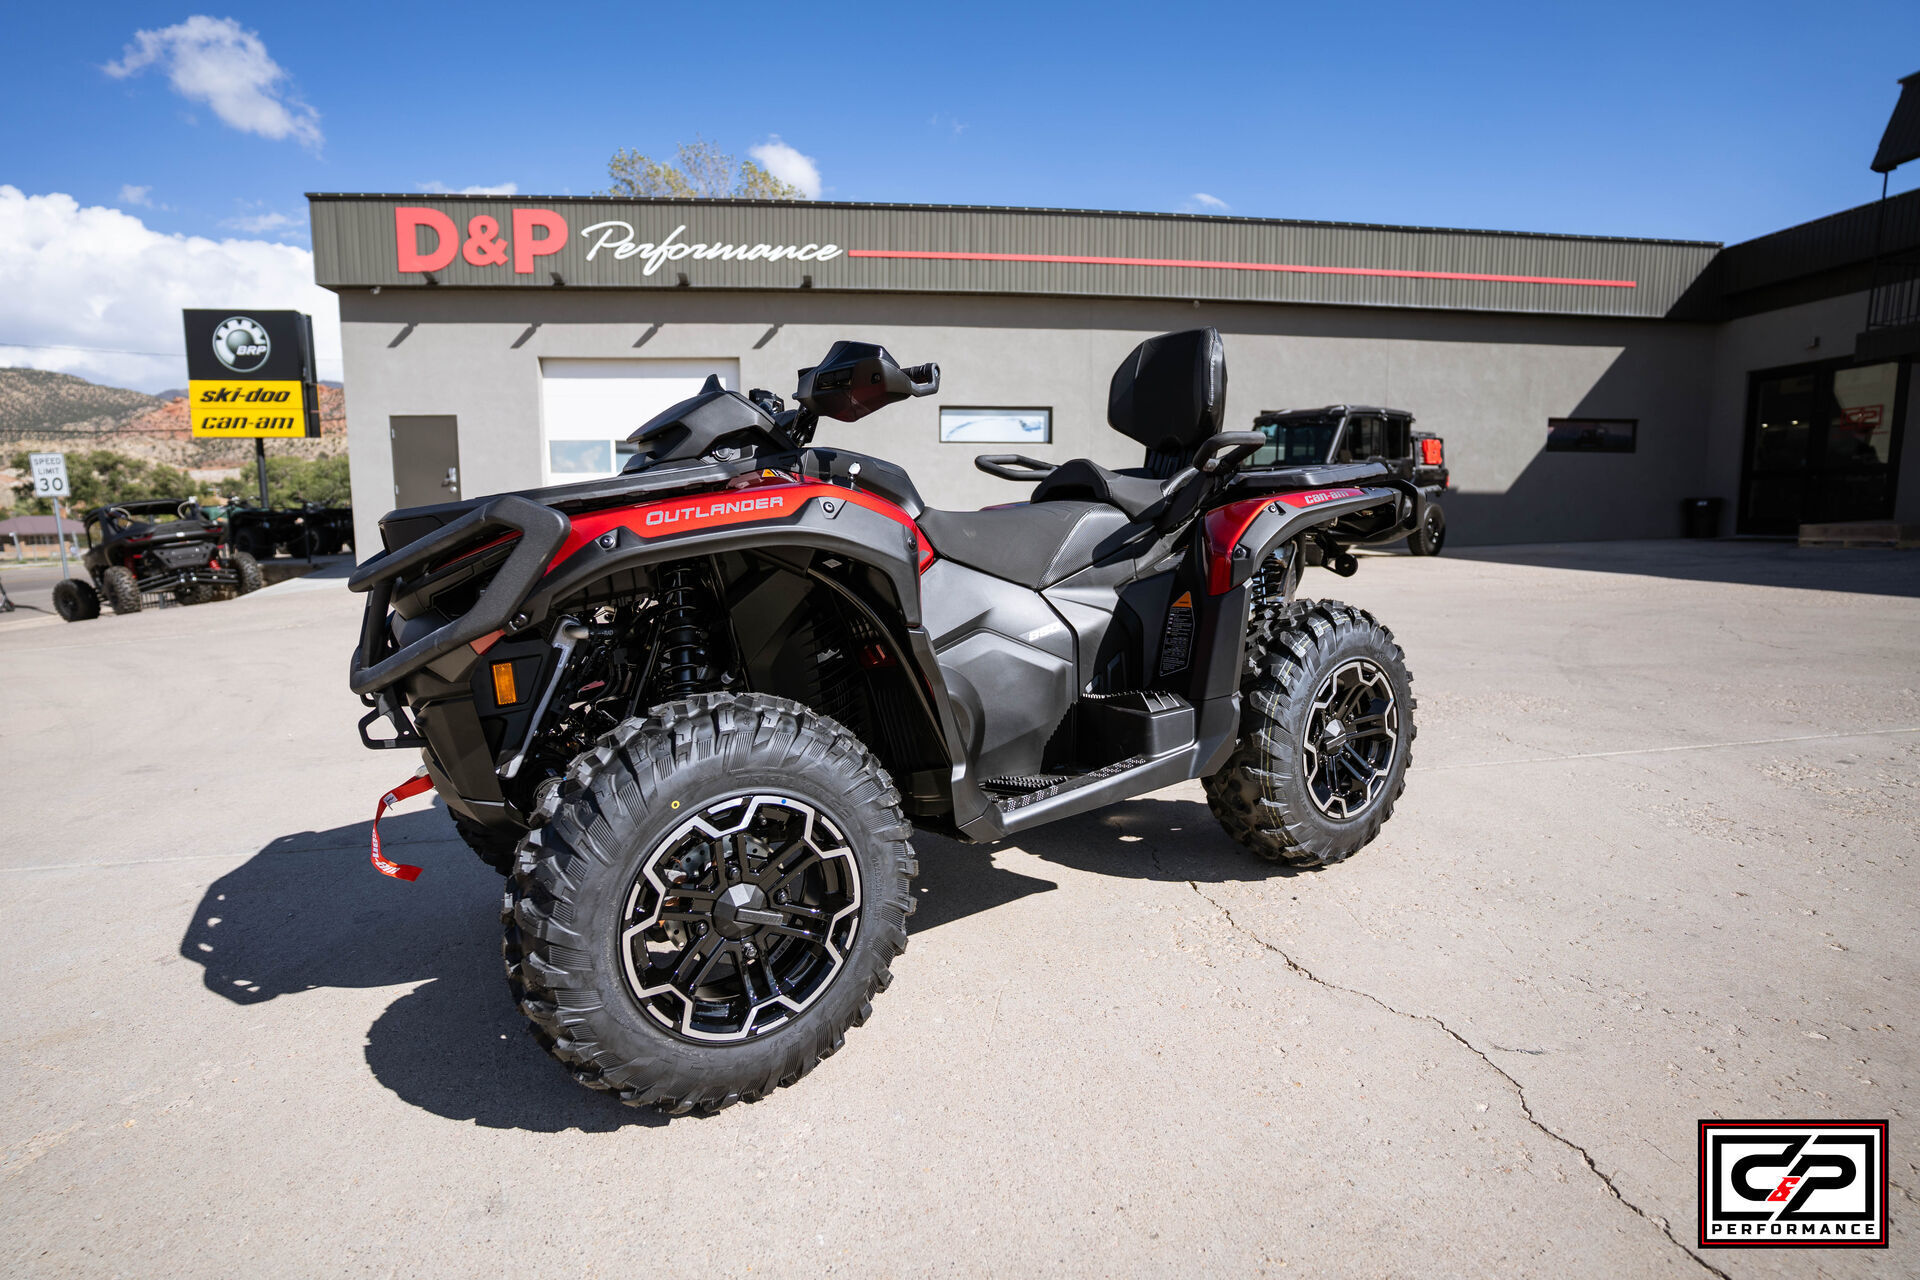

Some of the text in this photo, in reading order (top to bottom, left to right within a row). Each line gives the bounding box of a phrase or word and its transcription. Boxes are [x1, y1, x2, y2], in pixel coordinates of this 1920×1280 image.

[395, 207, 844, 276] D&P Performance
[236, 345, 267, 356] BRP
[200, 387, 290, 402] ski-doo
[201, 417, 295, 429] can-am
[33, 457, 61, 465] SPEED
[38, 467, 59, 475] LIMIT
[40, 477, 63, 492] 30
[1304, 490, 1349, 504] can-am
[646, 496, 783, 526] OUTLANDER
[1028, 621, 1061, 642] 850
